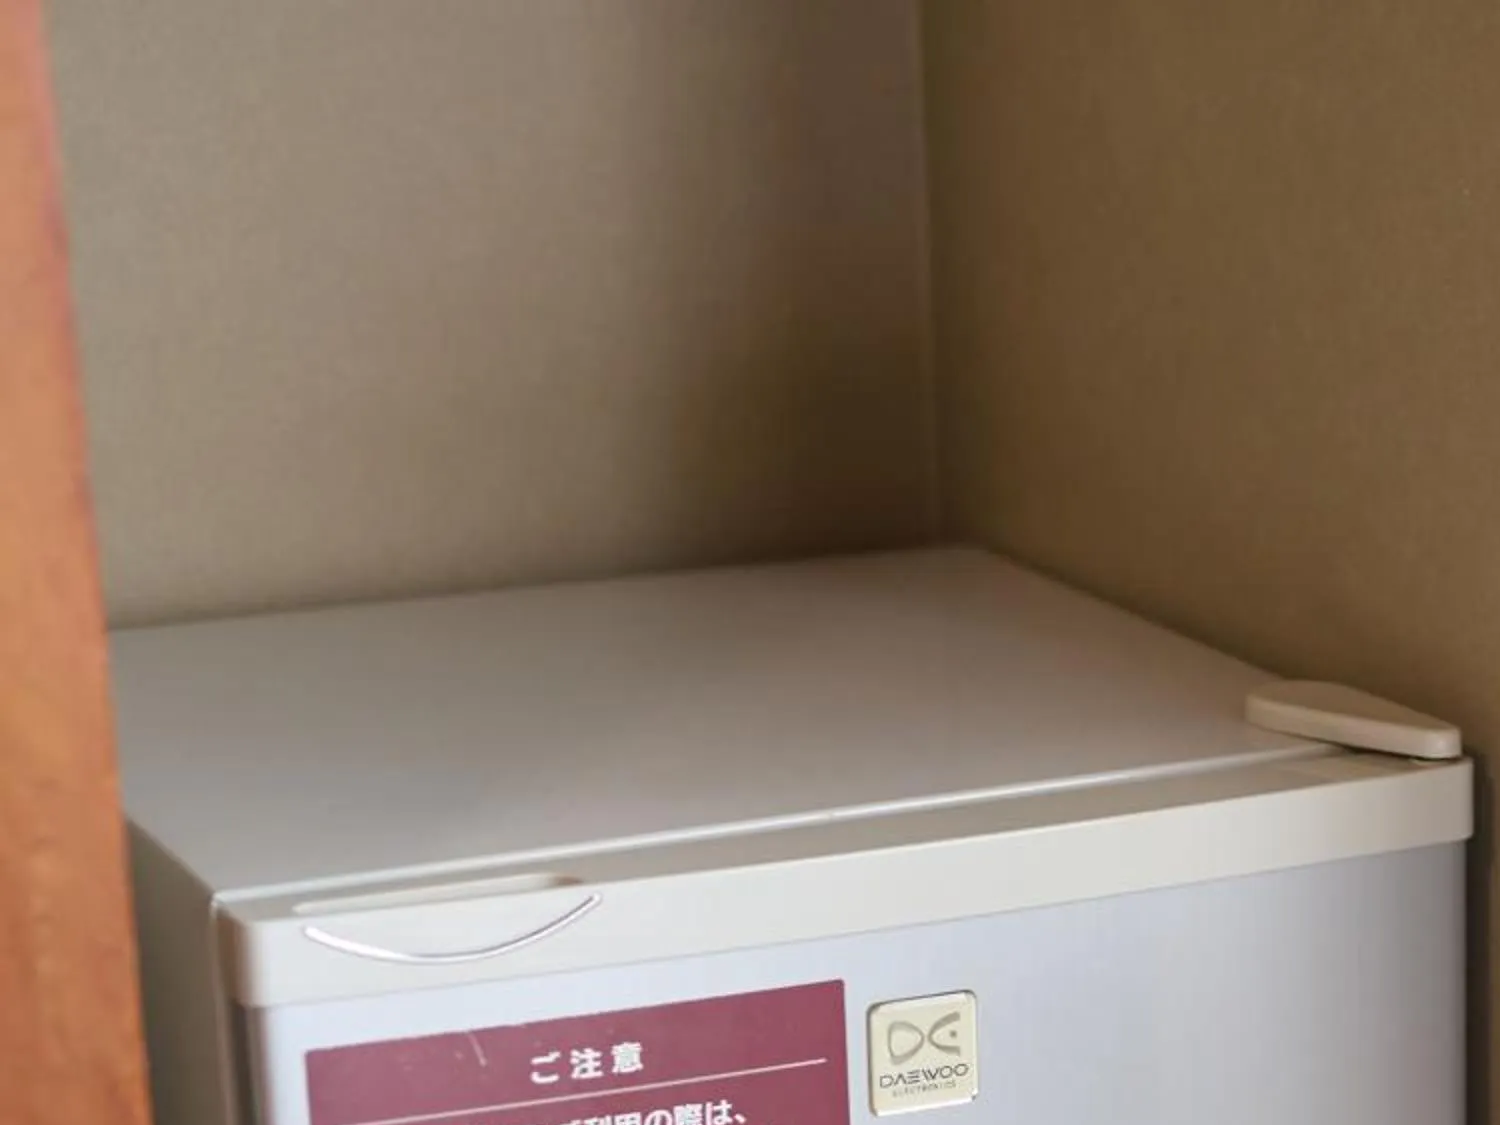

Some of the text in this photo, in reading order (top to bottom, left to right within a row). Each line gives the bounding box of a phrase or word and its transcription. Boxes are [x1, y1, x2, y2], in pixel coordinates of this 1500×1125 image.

[530, 1042, 644, 1084] ご注意
[879, 1063, 969, 1089] DAEWOO
